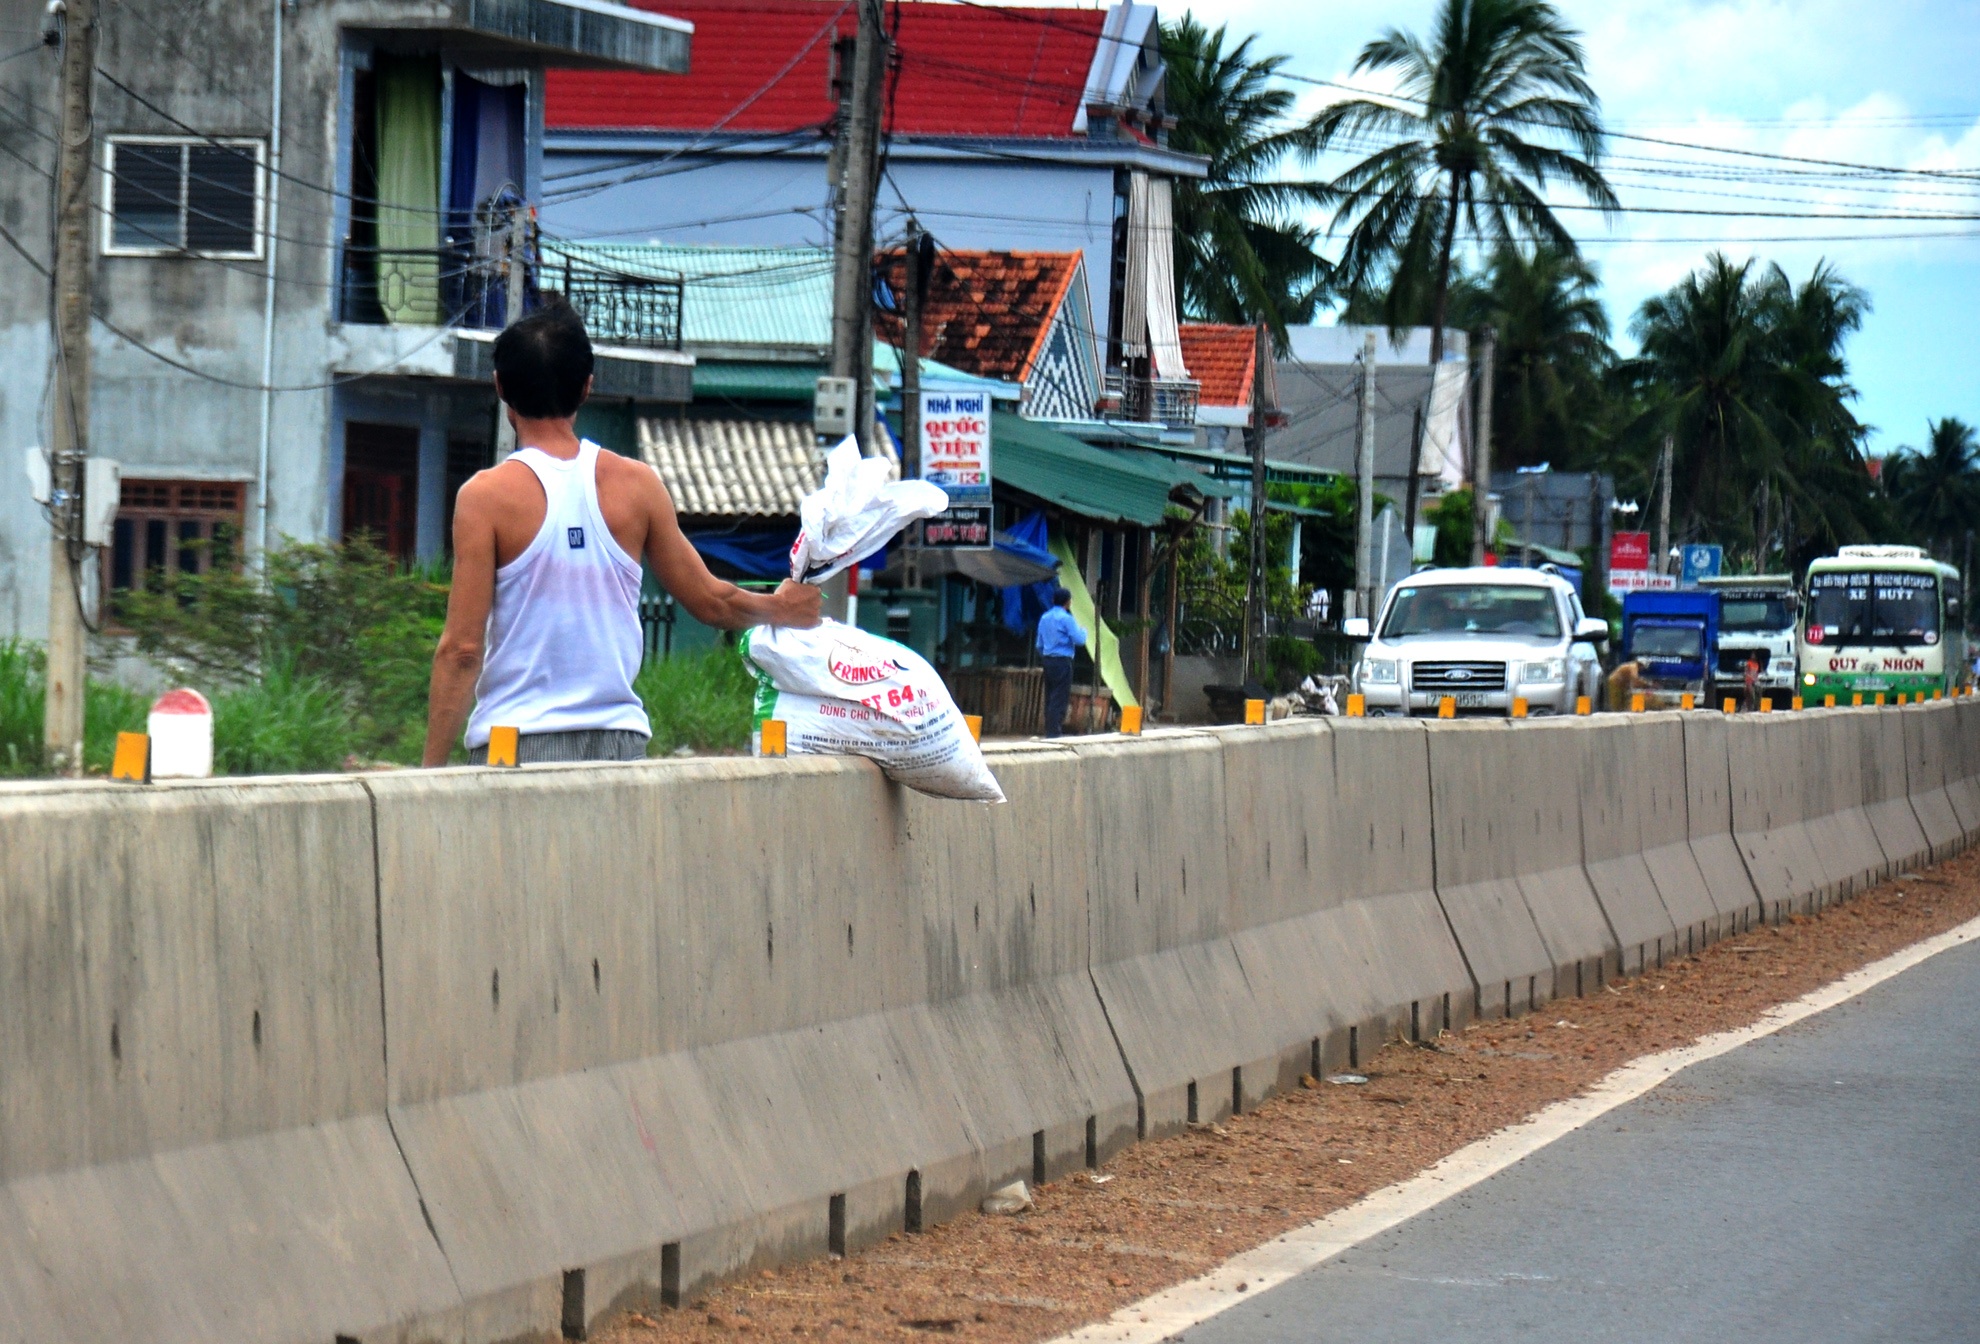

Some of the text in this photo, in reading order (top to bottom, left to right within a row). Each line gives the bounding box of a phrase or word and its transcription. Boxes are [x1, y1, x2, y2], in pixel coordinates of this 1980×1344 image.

[925, 416, 986, 438] QUỐC
[929, 437, 982, 459] VIỆT
[1849, 588, 1867, 600] XE
[1829, 657, 1924, 672] QUY NHƠN
[887, 685, 914, 708] 64
[850, 709, 870, 721] CHO
